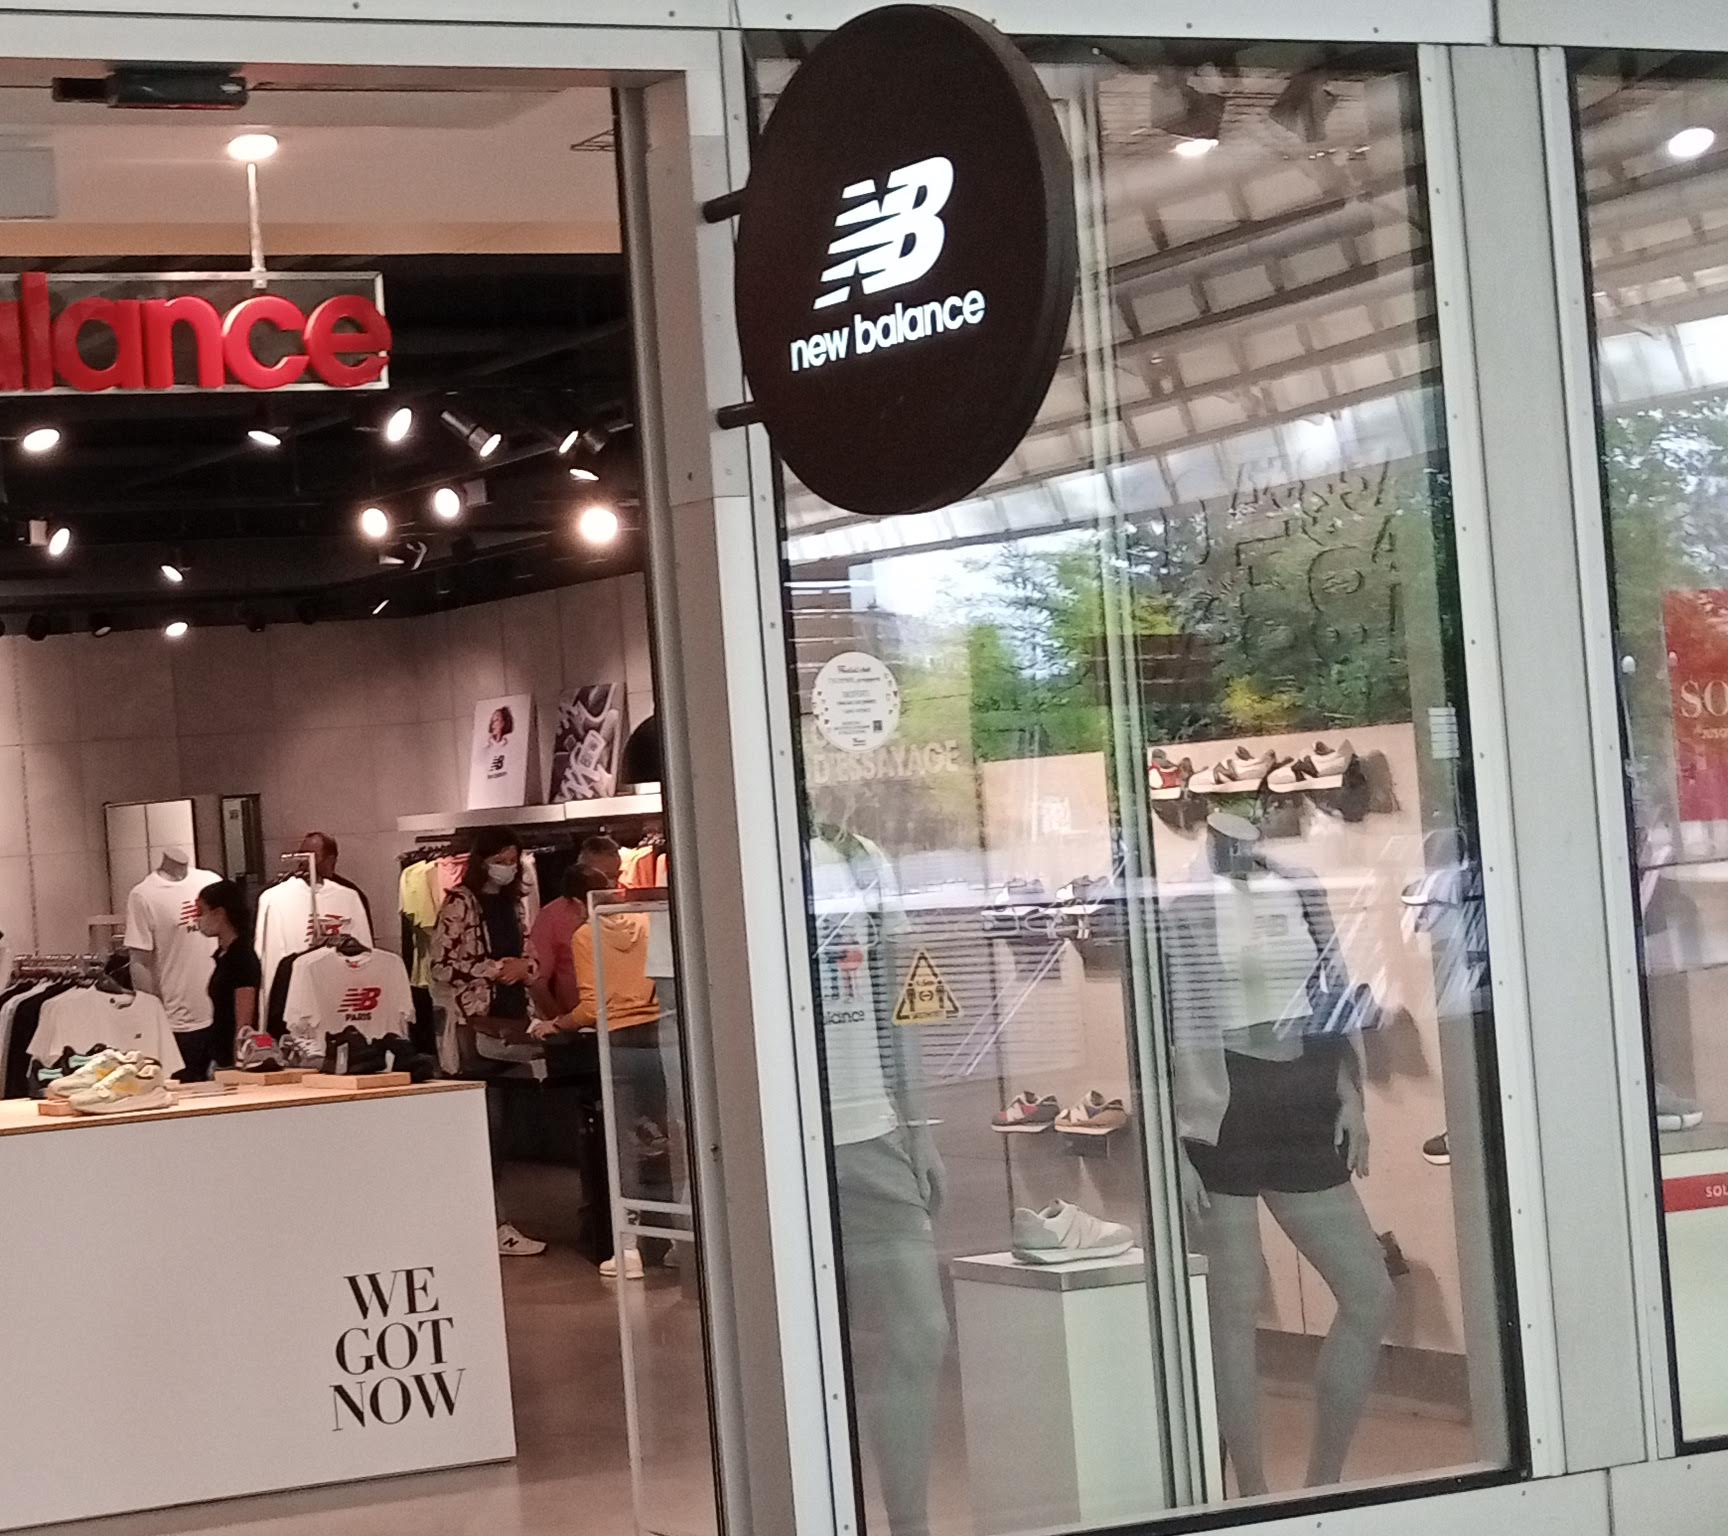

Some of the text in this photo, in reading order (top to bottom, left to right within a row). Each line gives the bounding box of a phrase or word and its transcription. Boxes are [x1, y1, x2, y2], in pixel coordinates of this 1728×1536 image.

[790, 290, 986, 372] new balance
[343, 1266, 440, 1320] WE
[335, 1317, 455, 1376] GOT
[329, 1368, 467, 1431] NOW
